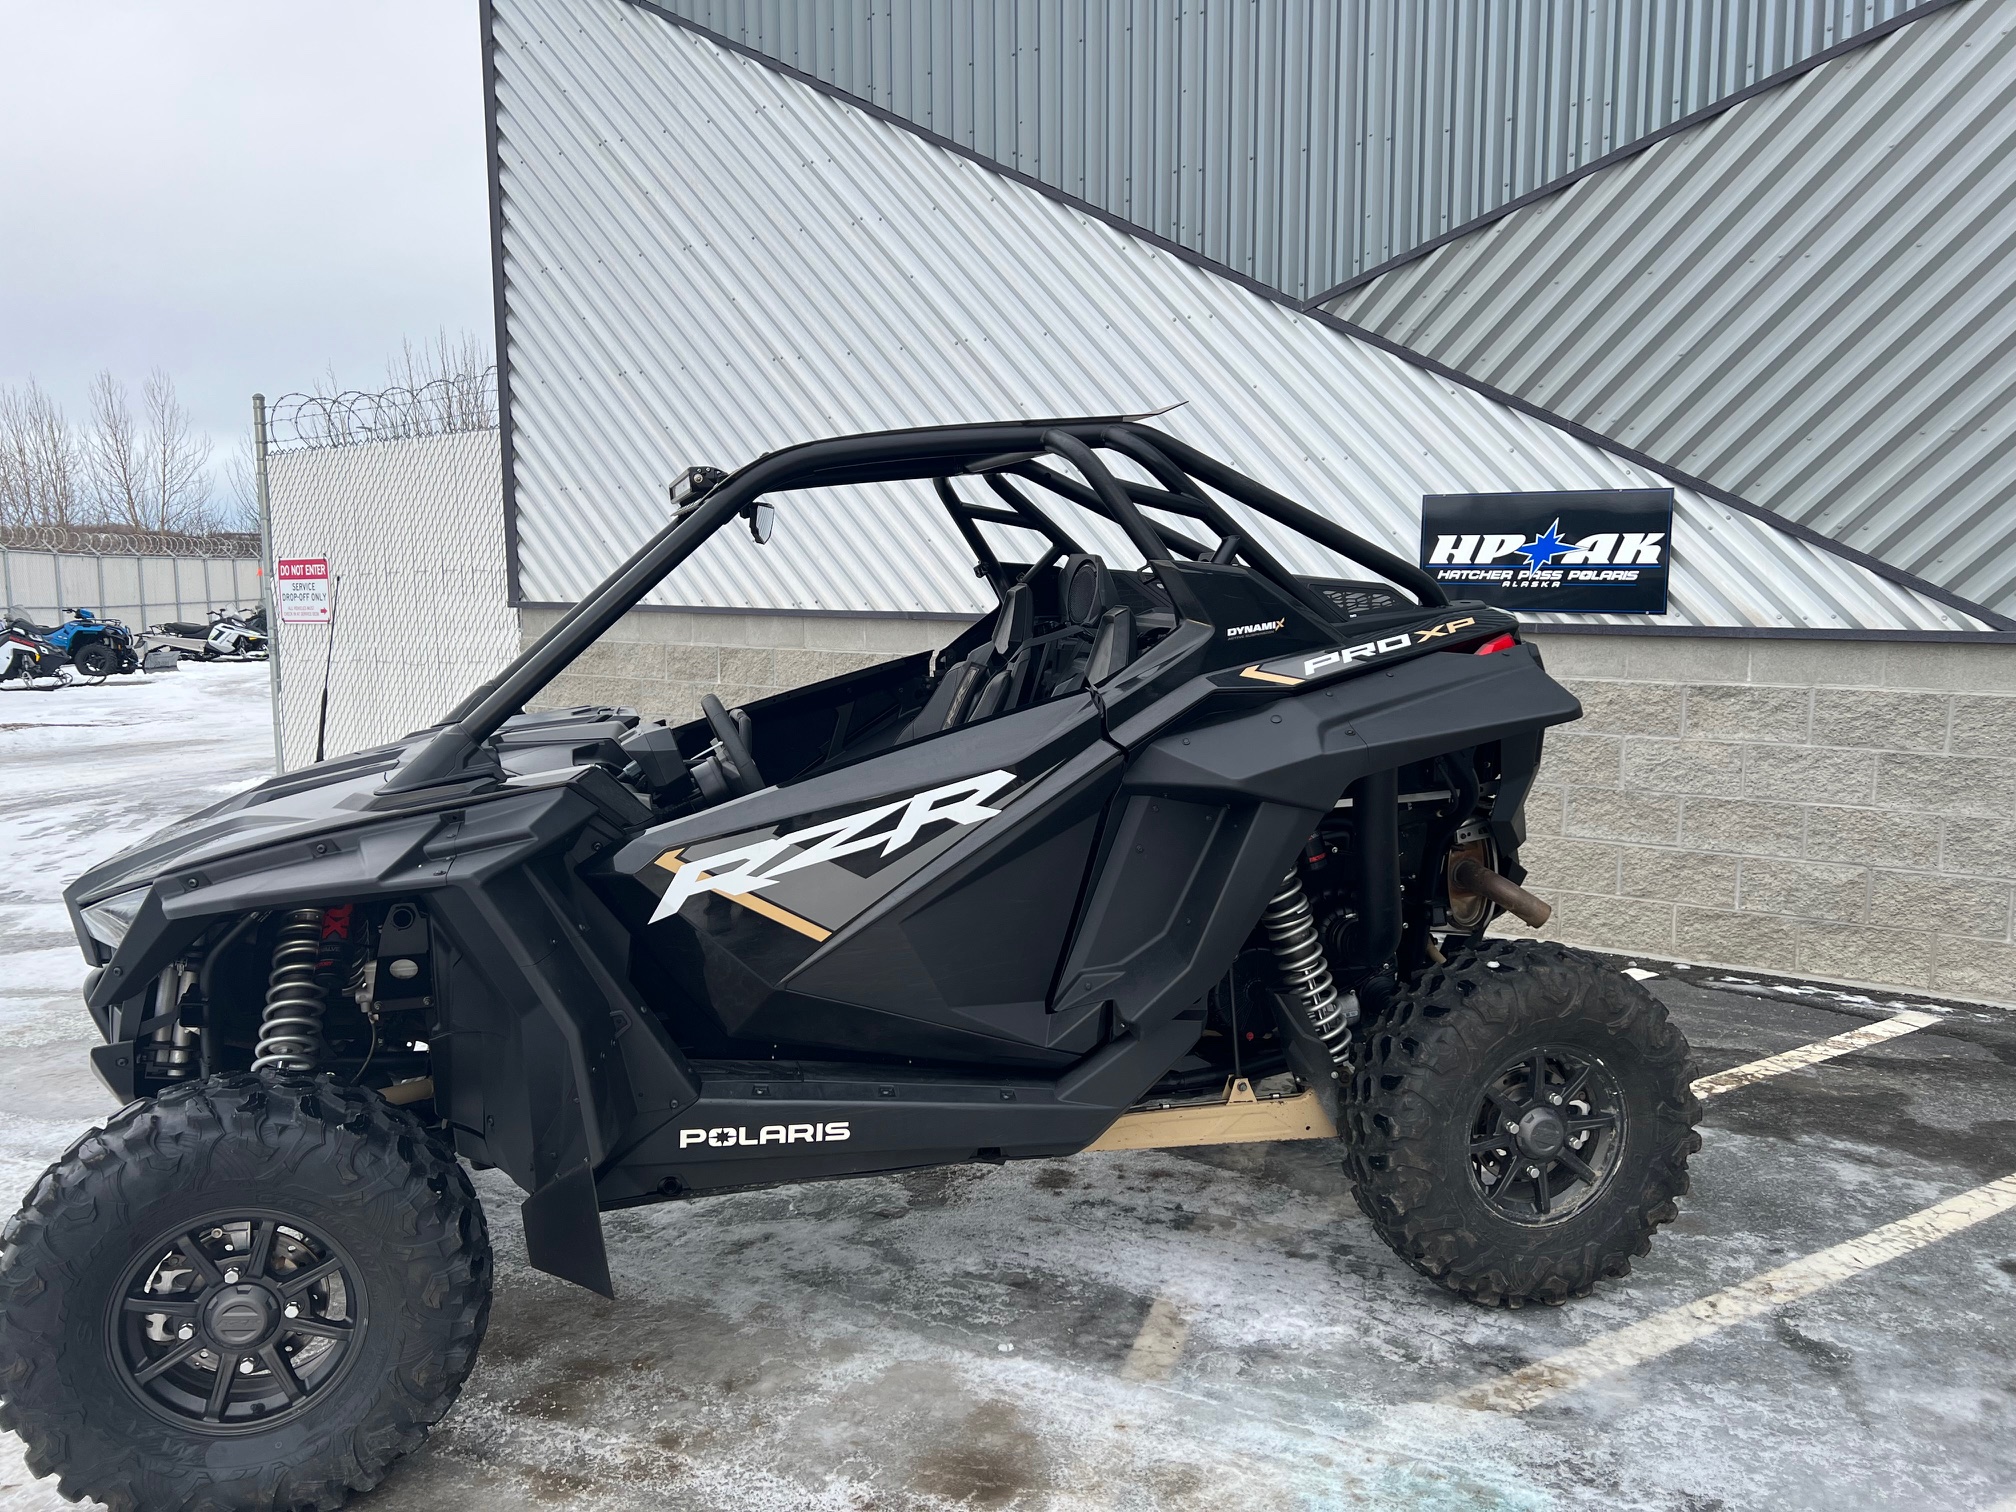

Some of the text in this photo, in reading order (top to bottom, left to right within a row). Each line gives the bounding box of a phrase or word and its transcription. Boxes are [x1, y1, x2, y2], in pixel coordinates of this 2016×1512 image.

[1429, 532, 1666, 564] HP AK
[280, 564, 326, 576] DO NOT ENTER
[1437, 569, 1640, 581] HATCHER PASS POLARIS
[292, 582, 316, 591] SERVICE
[1501, 580, 1561, 588] ALASKA
[282, 593, 327, 601] DROP-OFF ONLY
[1227, 617, 1285, 637] DYNAMIX
[1304, 617, 1475, 676] PRO XP
[647, 769, 1018, 925] RZR
[679, 1121, 851, 1149] POLARIS
